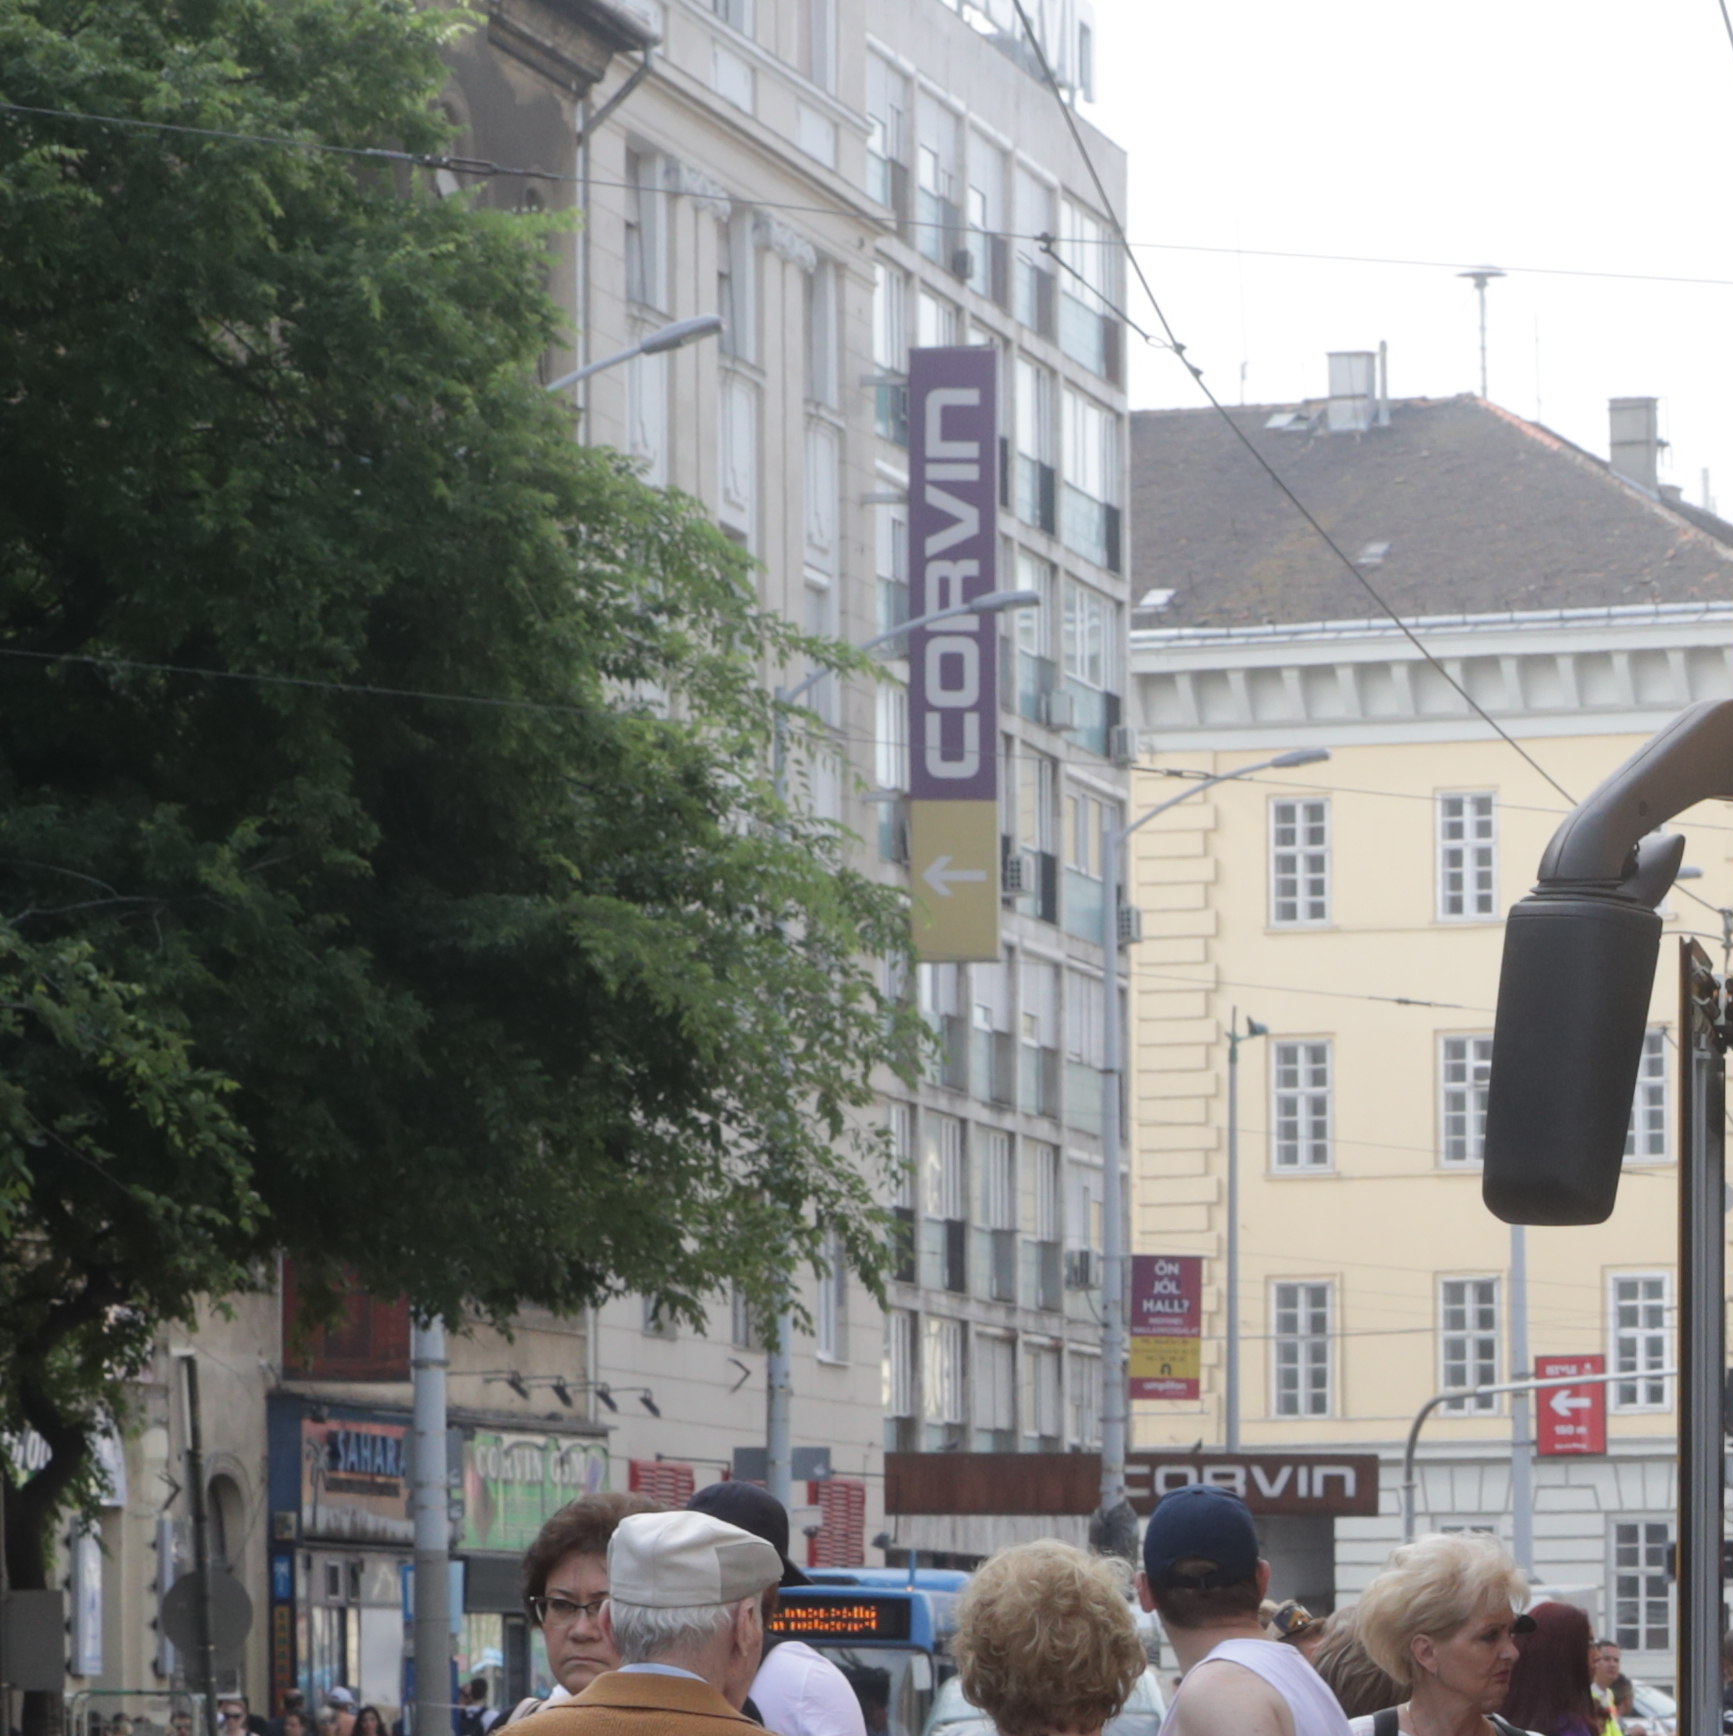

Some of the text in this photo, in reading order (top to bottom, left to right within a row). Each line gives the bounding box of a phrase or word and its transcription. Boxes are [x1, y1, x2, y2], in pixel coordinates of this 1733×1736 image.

[924, 386, 981, 780] CORVIN
[1154, 1259, 1180, 1276] ÖN
[1153, 1276, 1181, 1295] JÓL
[1142, 1299, 1190, 1314] HALL?
[1123, 1465, 1356, 1498] CORVIN
